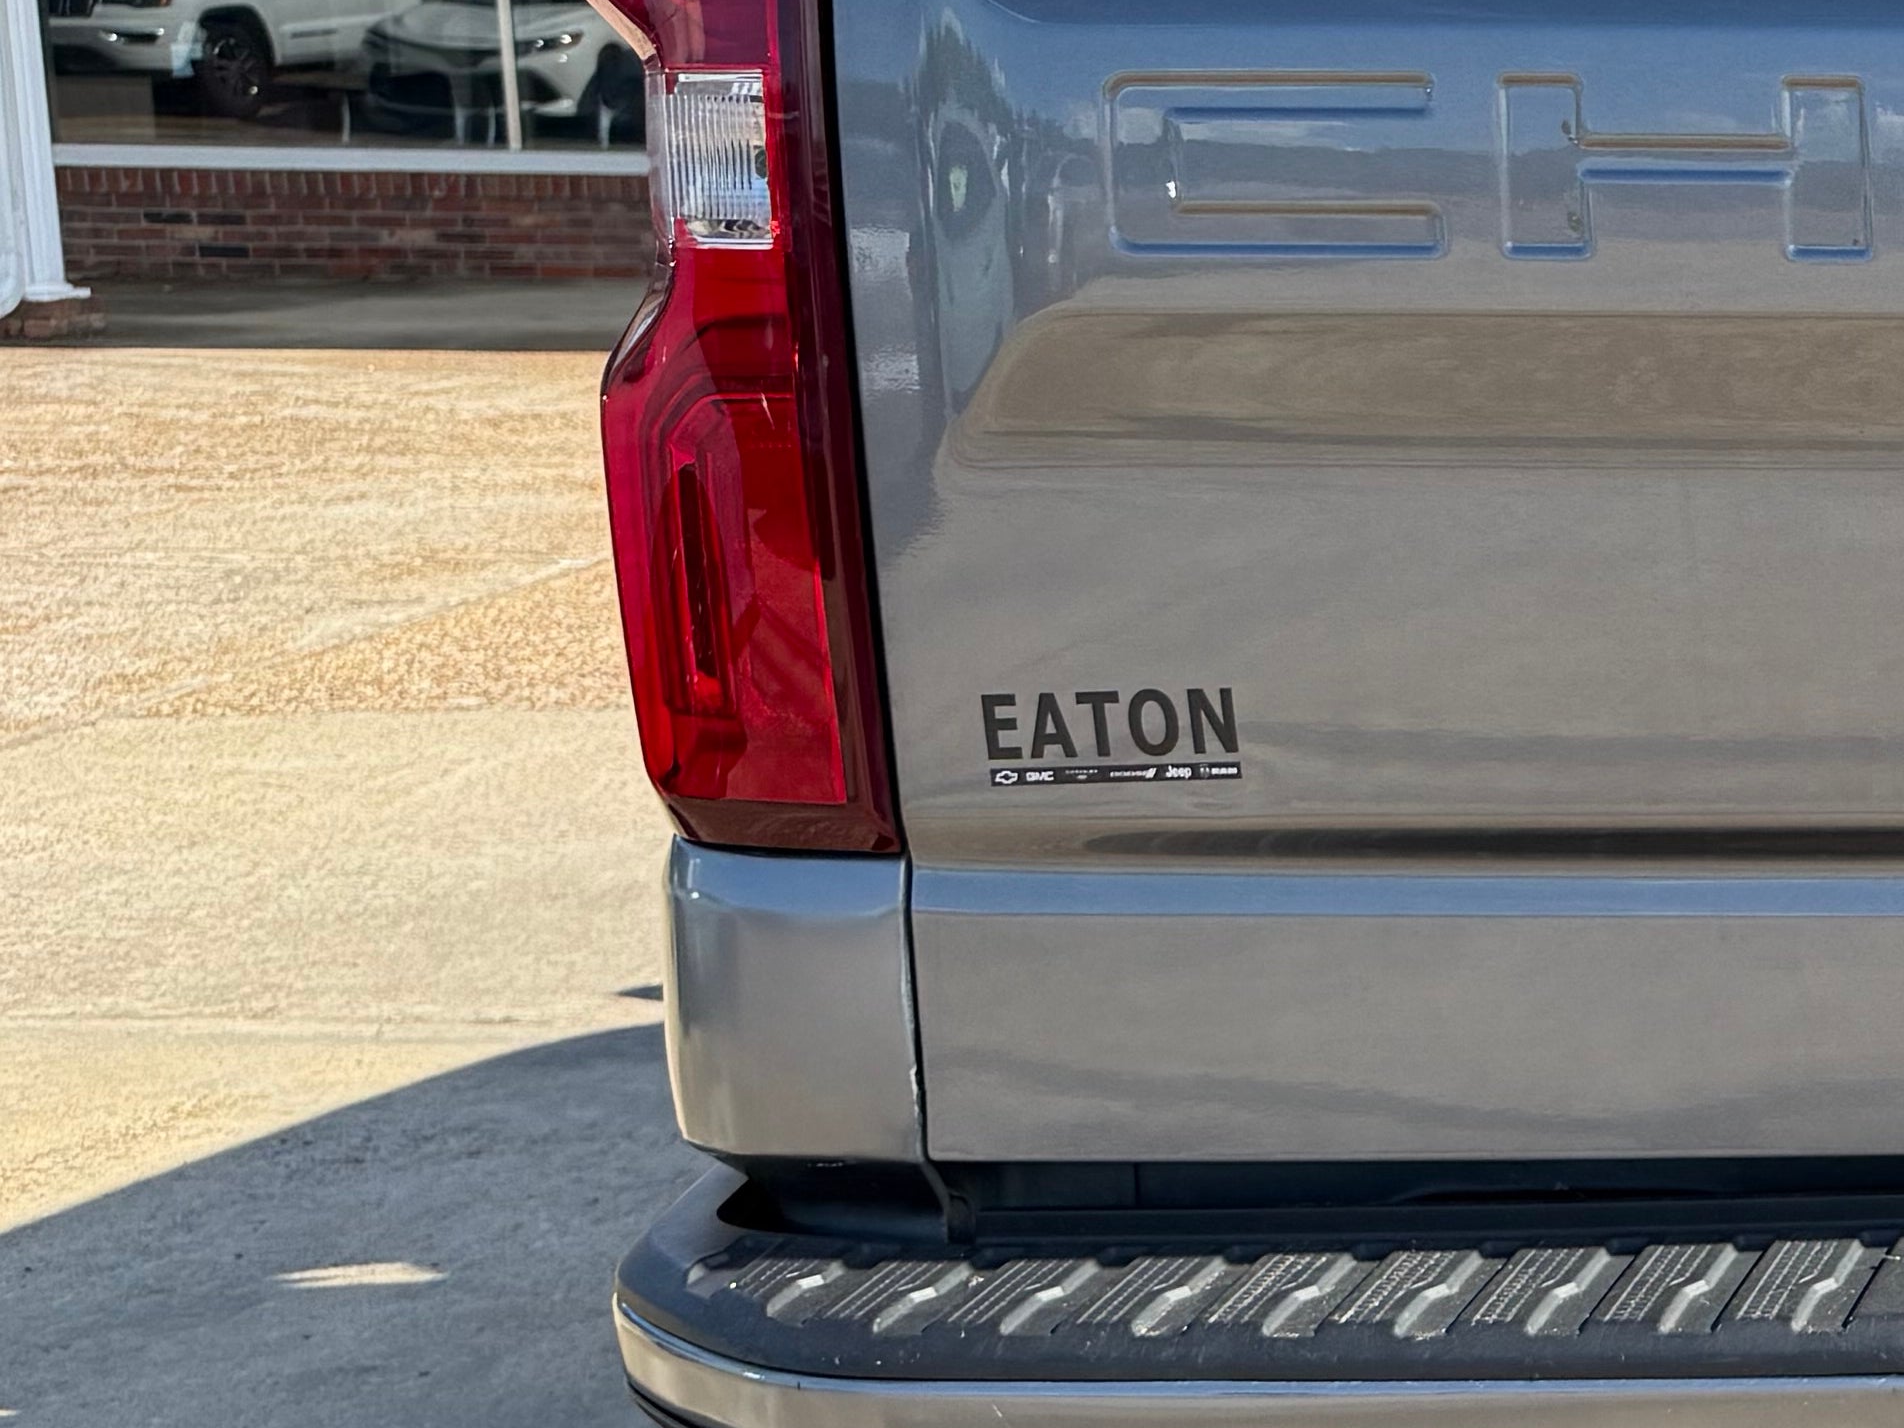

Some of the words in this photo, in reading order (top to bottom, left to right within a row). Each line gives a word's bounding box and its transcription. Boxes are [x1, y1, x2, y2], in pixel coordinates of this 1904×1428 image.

[981, 687, 1239, 760] EATON
[1025, 771, 1055, 782] GMC
[1166, 765, 1192, 779] Jeep
